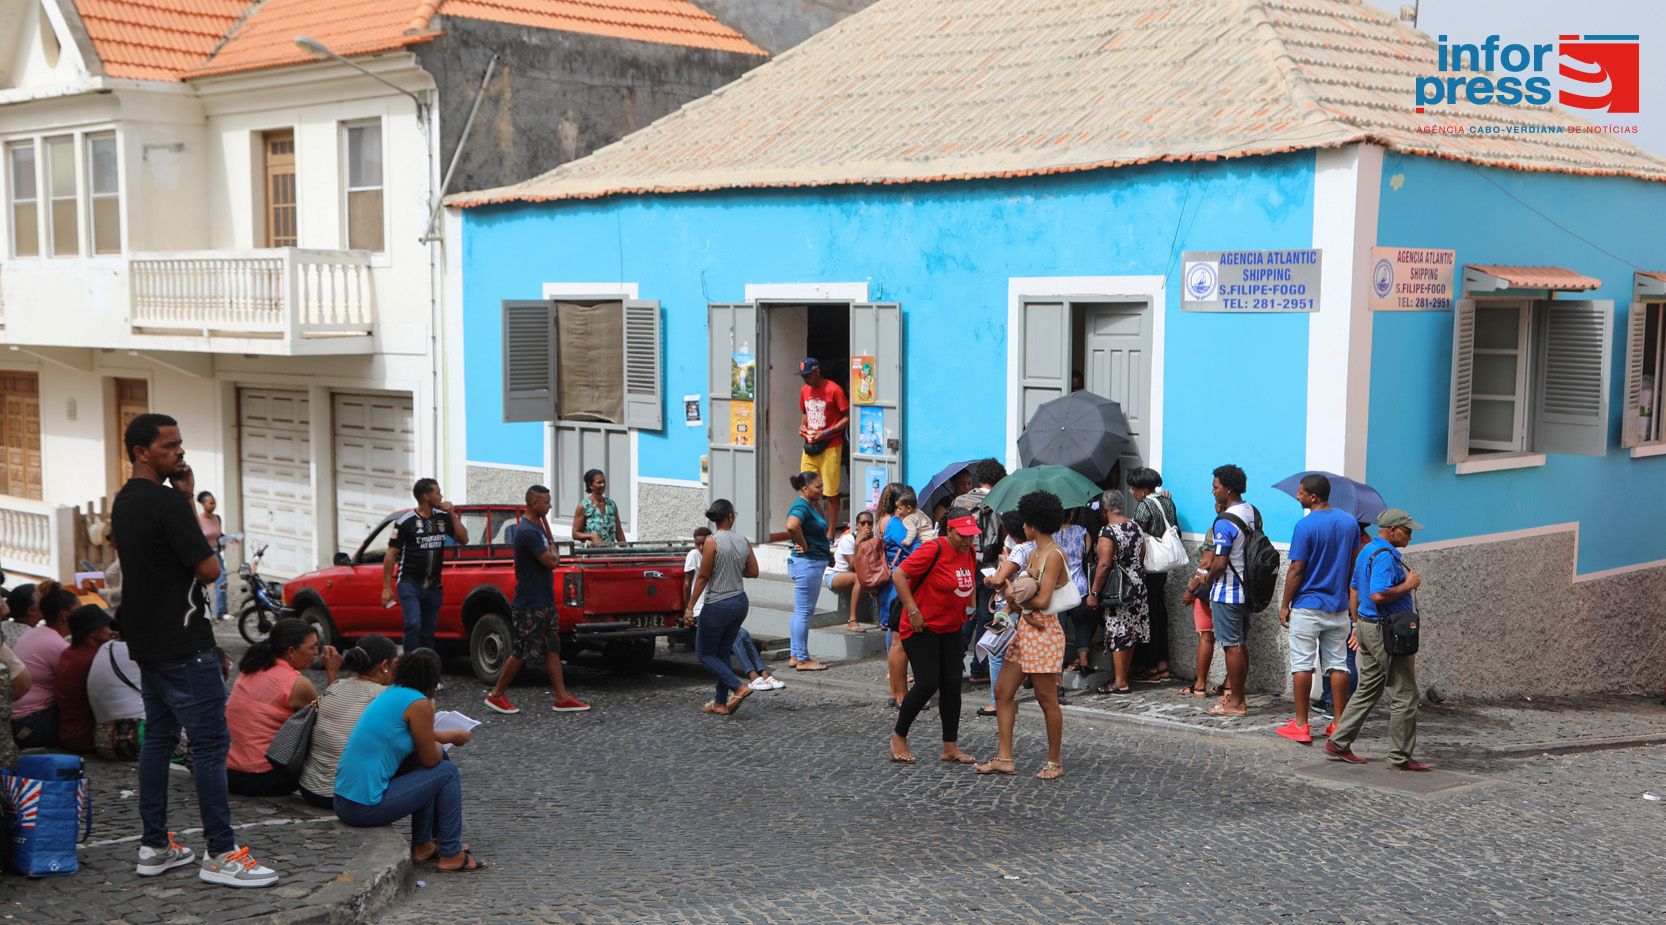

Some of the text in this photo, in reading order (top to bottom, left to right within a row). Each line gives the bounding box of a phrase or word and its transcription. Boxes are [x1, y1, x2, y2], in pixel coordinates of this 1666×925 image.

[1219, 251, 1317, 265] AGENCIA ATLANTIC
[1397, 250, 1453, 265] AGENCIA ATLANTIC
[1243, 269, 1291, 282] SHIPPING
[1410, 267, 1438, 281] SHIPPING
[1223, 298, 1314, 309] TEL: 281-2951
[1398, 296, 1450, 309] TEL: 281-2951
